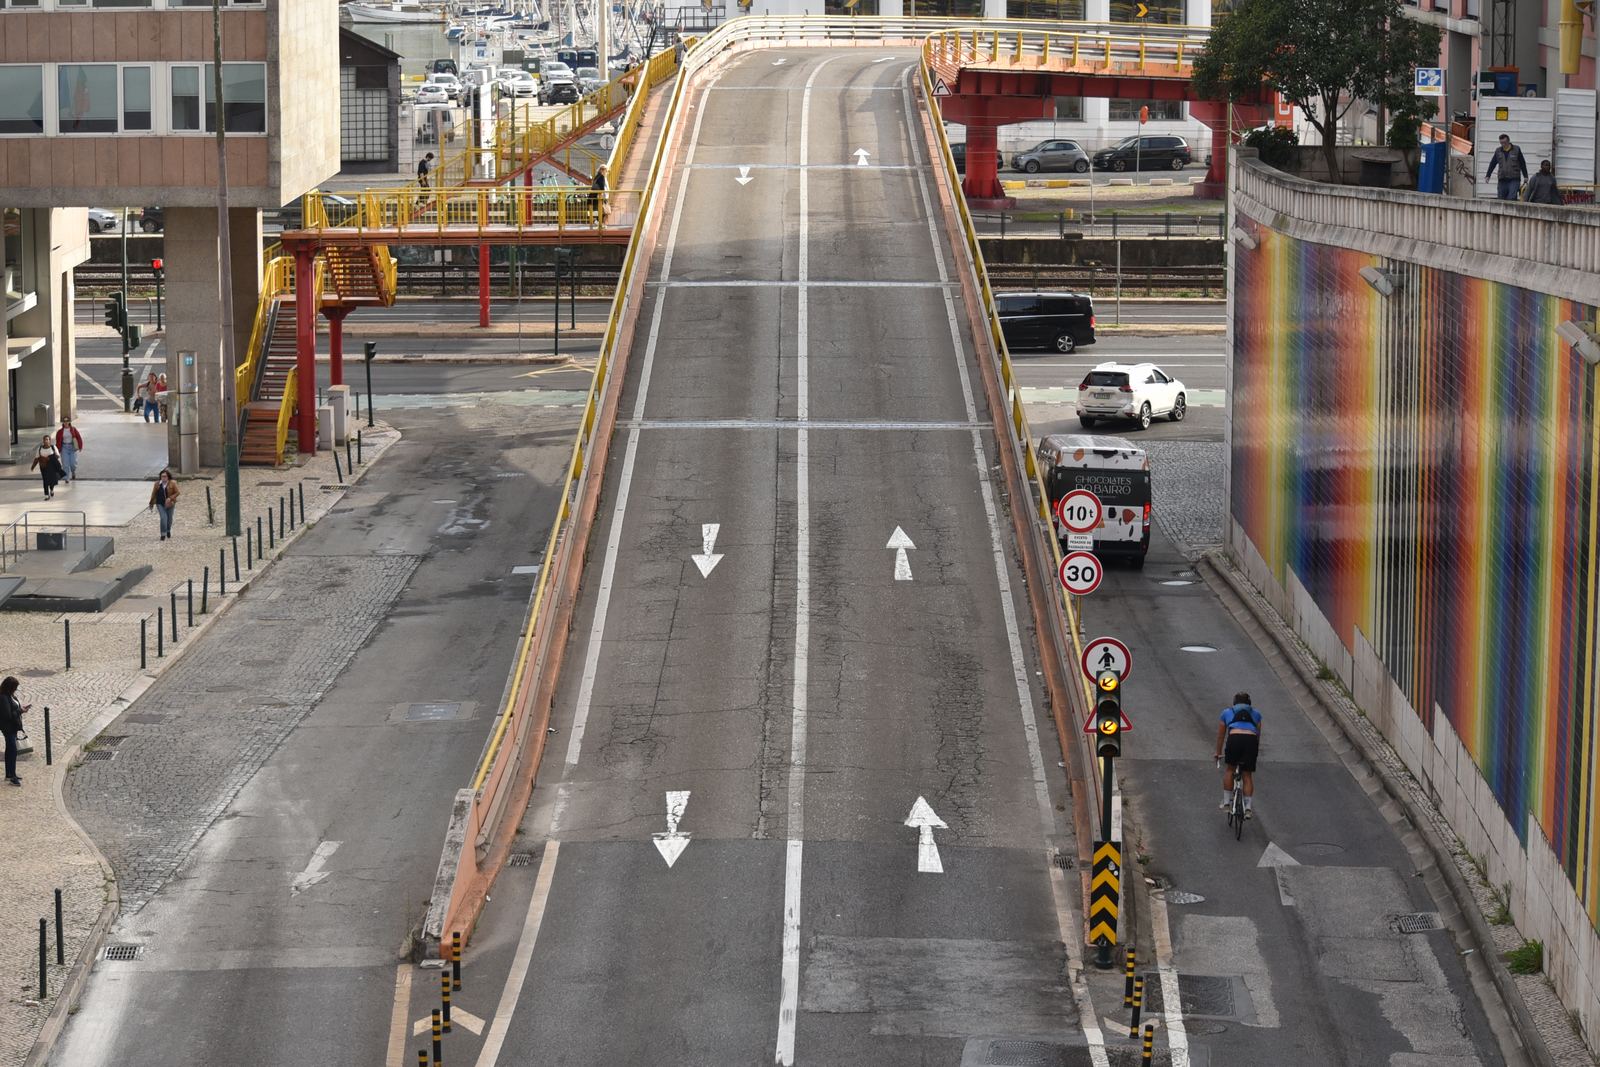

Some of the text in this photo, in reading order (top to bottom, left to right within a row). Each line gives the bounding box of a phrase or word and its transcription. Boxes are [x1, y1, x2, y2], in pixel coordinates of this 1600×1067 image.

[1418, 70, 1428, 84] P
[1075, 475, 1132, 485] CHOCOLATES
[1094, 484, 1132, 495] BAIRRO
[1067, 566, 1095, 582] 30
